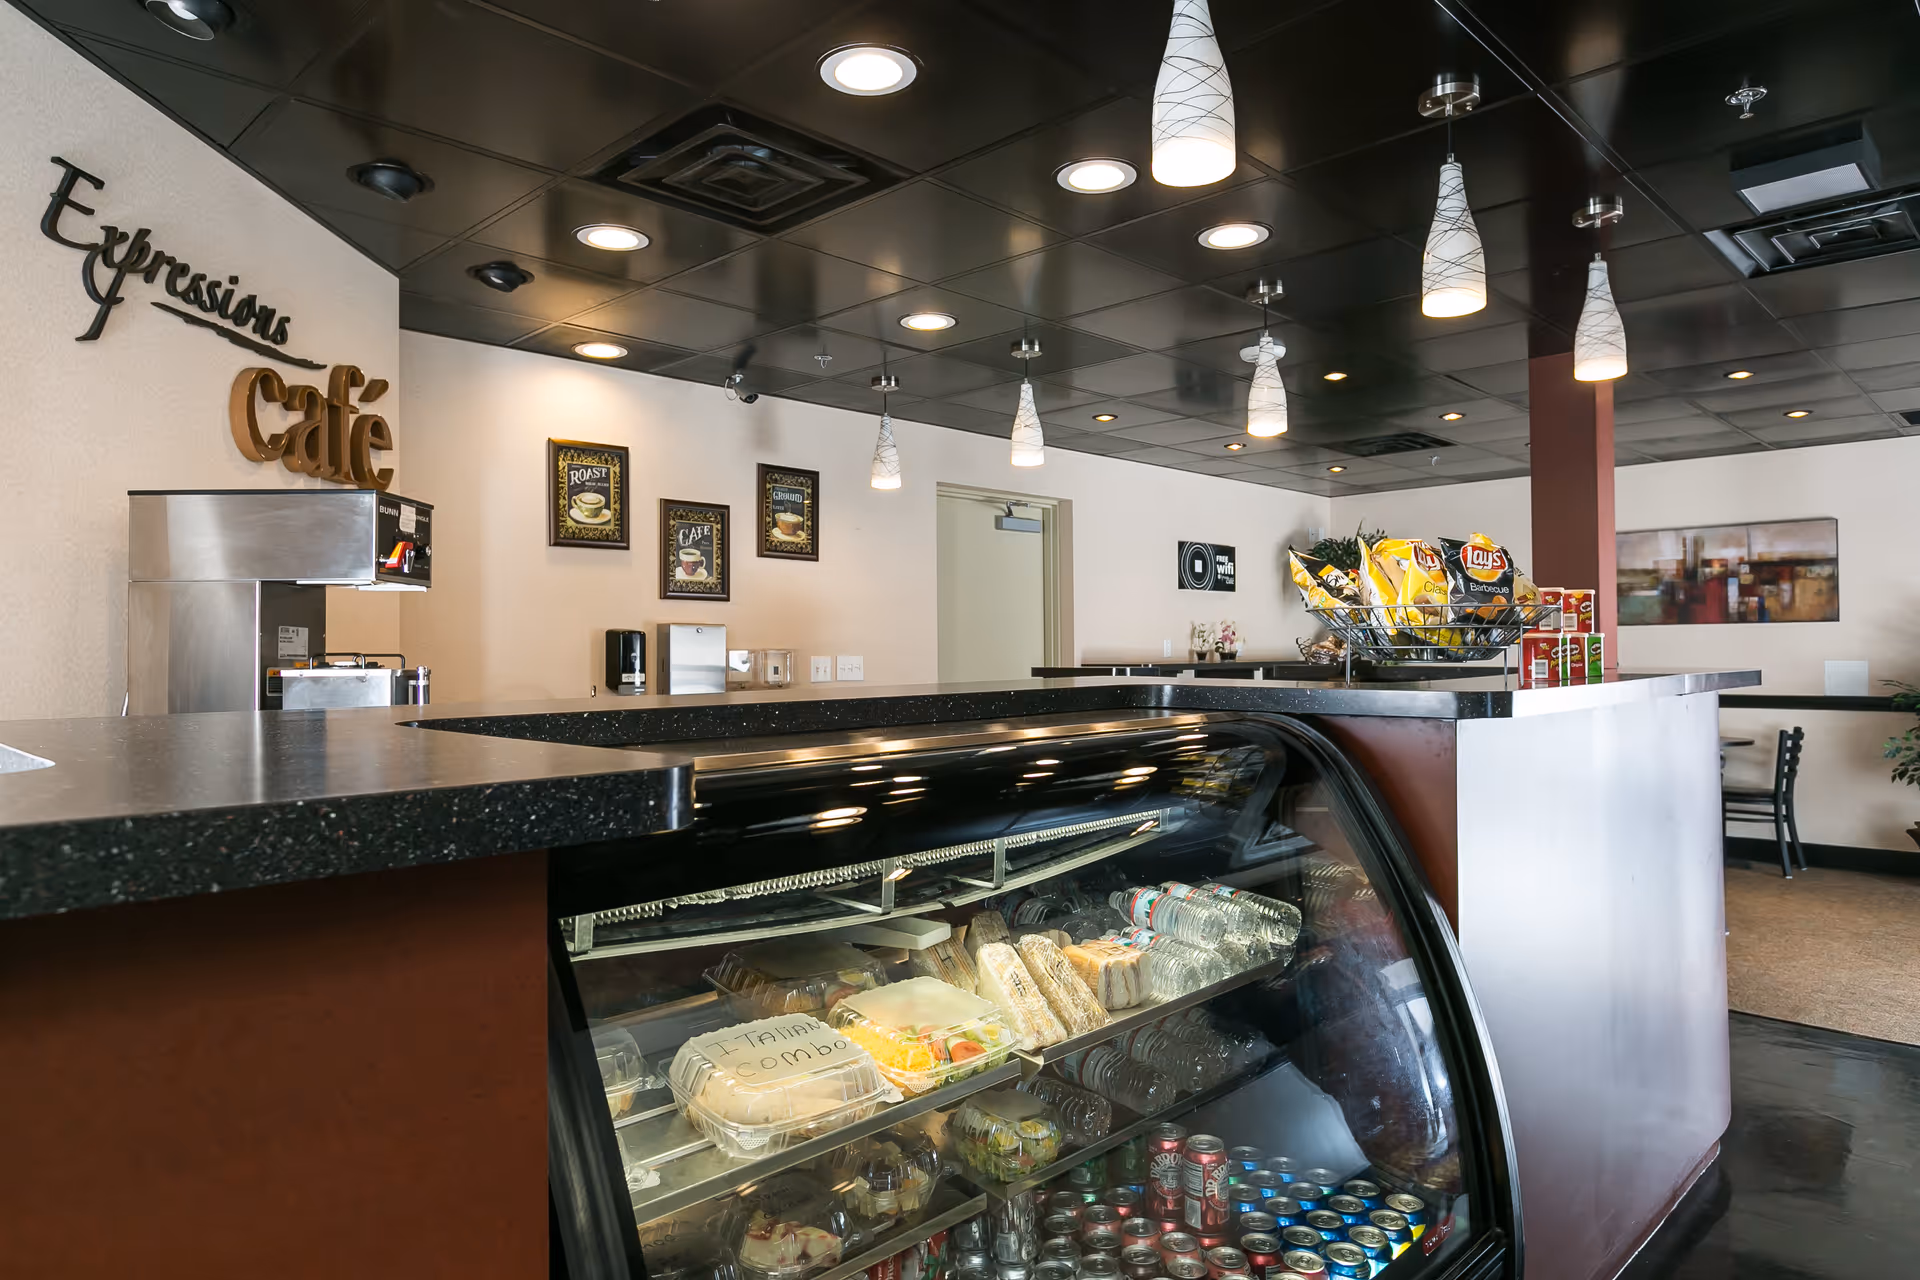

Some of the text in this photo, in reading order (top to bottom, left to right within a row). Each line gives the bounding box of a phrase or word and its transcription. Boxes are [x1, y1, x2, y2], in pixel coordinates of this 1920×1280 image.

[40, 156, 291, 341] Expressions
[230, 365, 394, 492] Café
[569, 467, 608, 486] ROAST
[380, 505, 399, 517] BUNN
[679, 525, 710, 546] CAFE
[1216, 555, 1228, 563] FREE
[1466, 546, 1502, 570] Lay's
[1216, 562, 1234, 575] wifi
[1469, 582, 1510, 594] Barbecue
